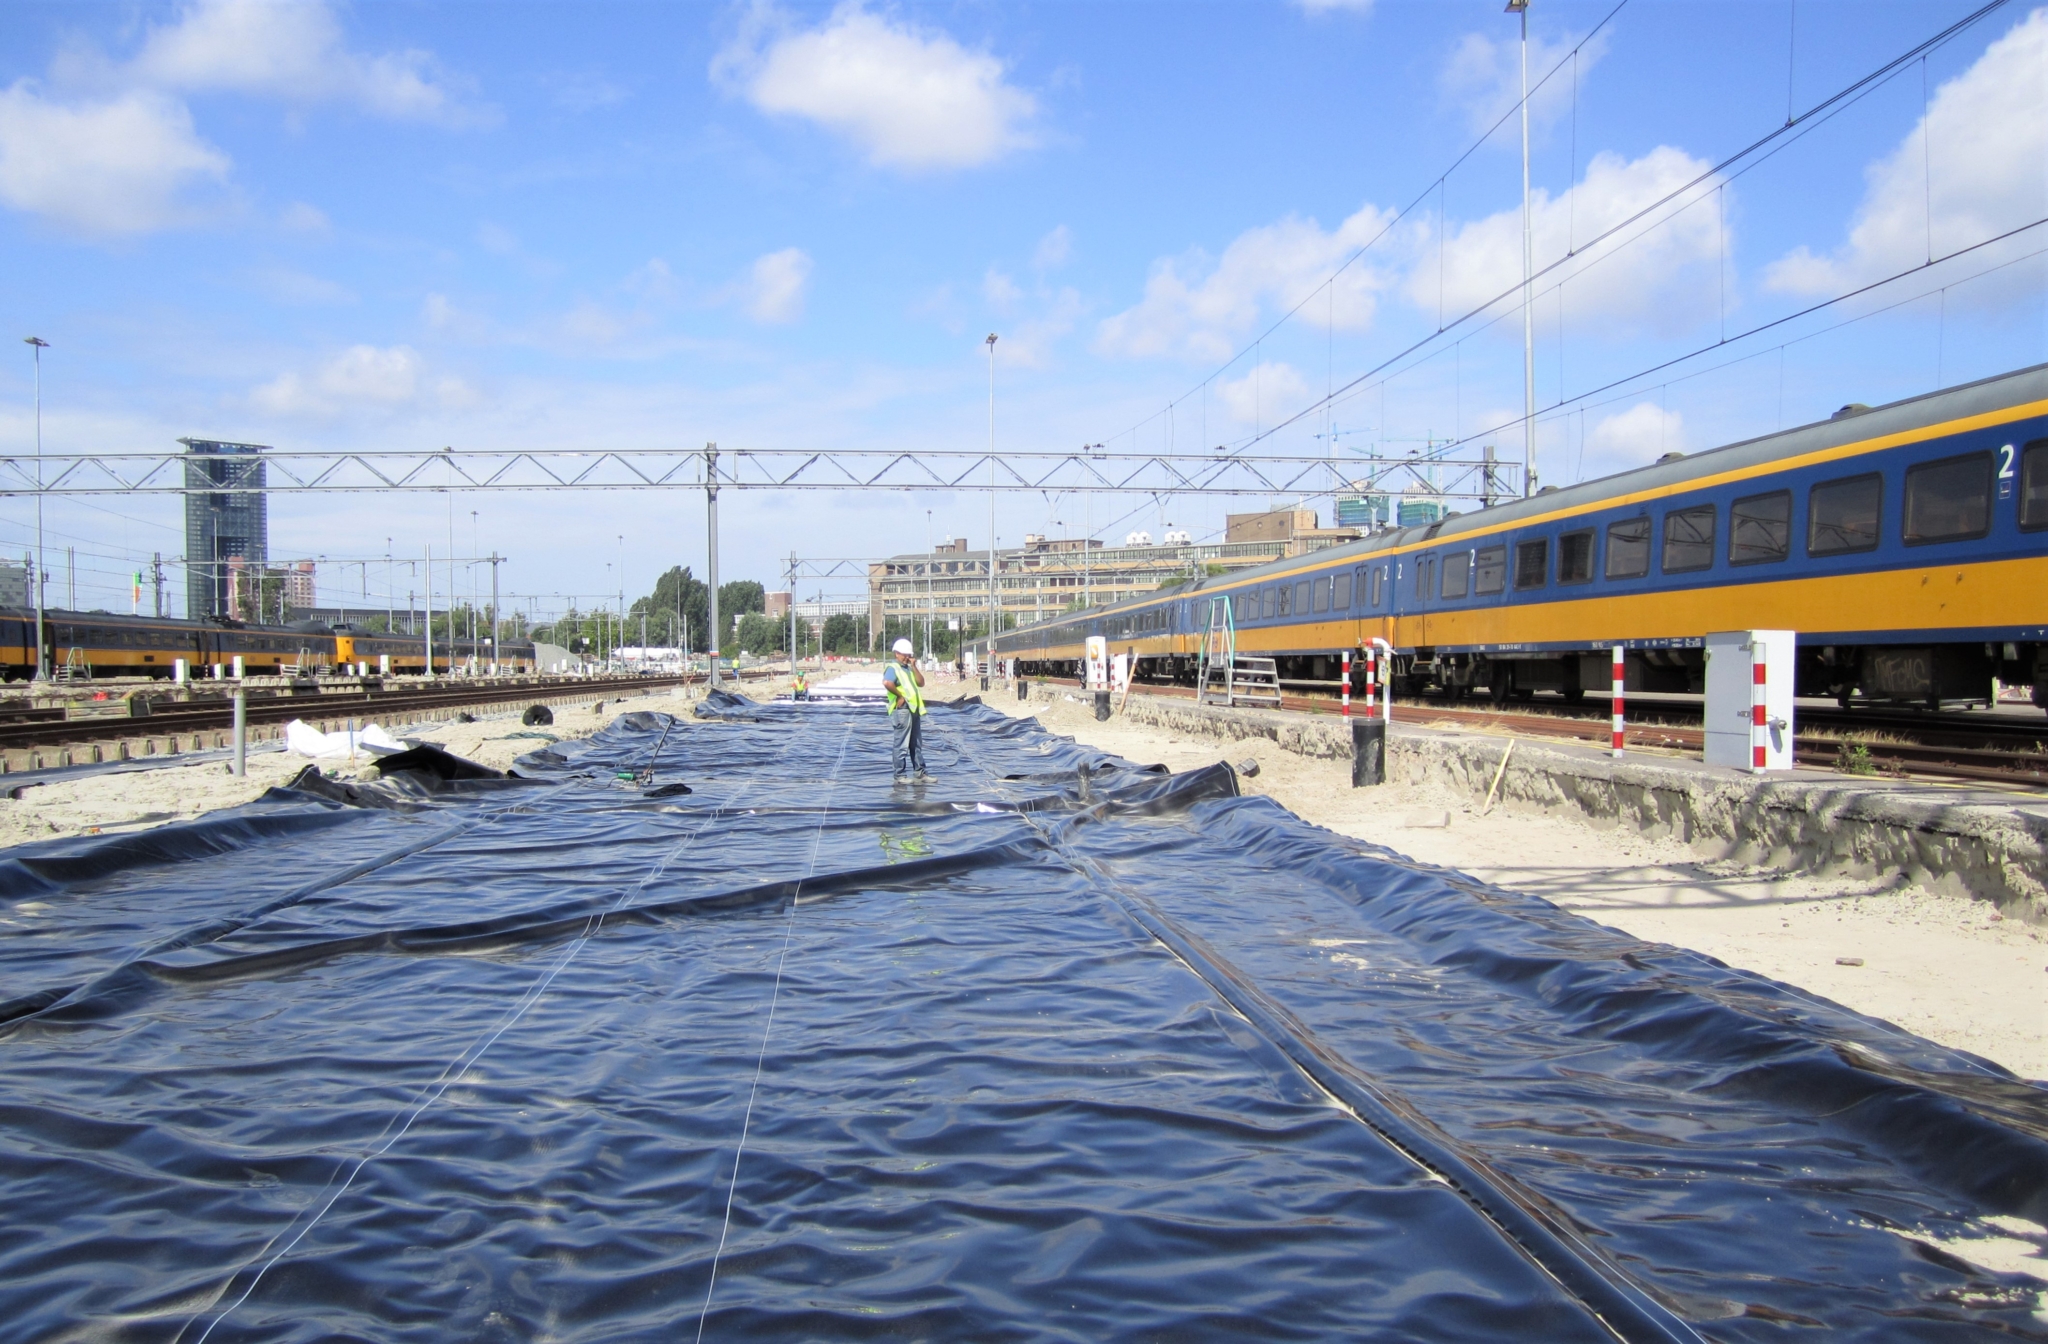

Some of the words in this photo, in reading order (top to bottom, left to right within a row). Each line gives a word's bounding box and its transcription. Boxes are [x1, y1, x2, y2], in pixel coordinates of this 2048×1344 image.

[1999, 444, 2014, 479] 2
[1469, 548, 1476, 567] 2
[1383, 565, 1389, 580] 2
[1397, 563, 1403, 580] 2
